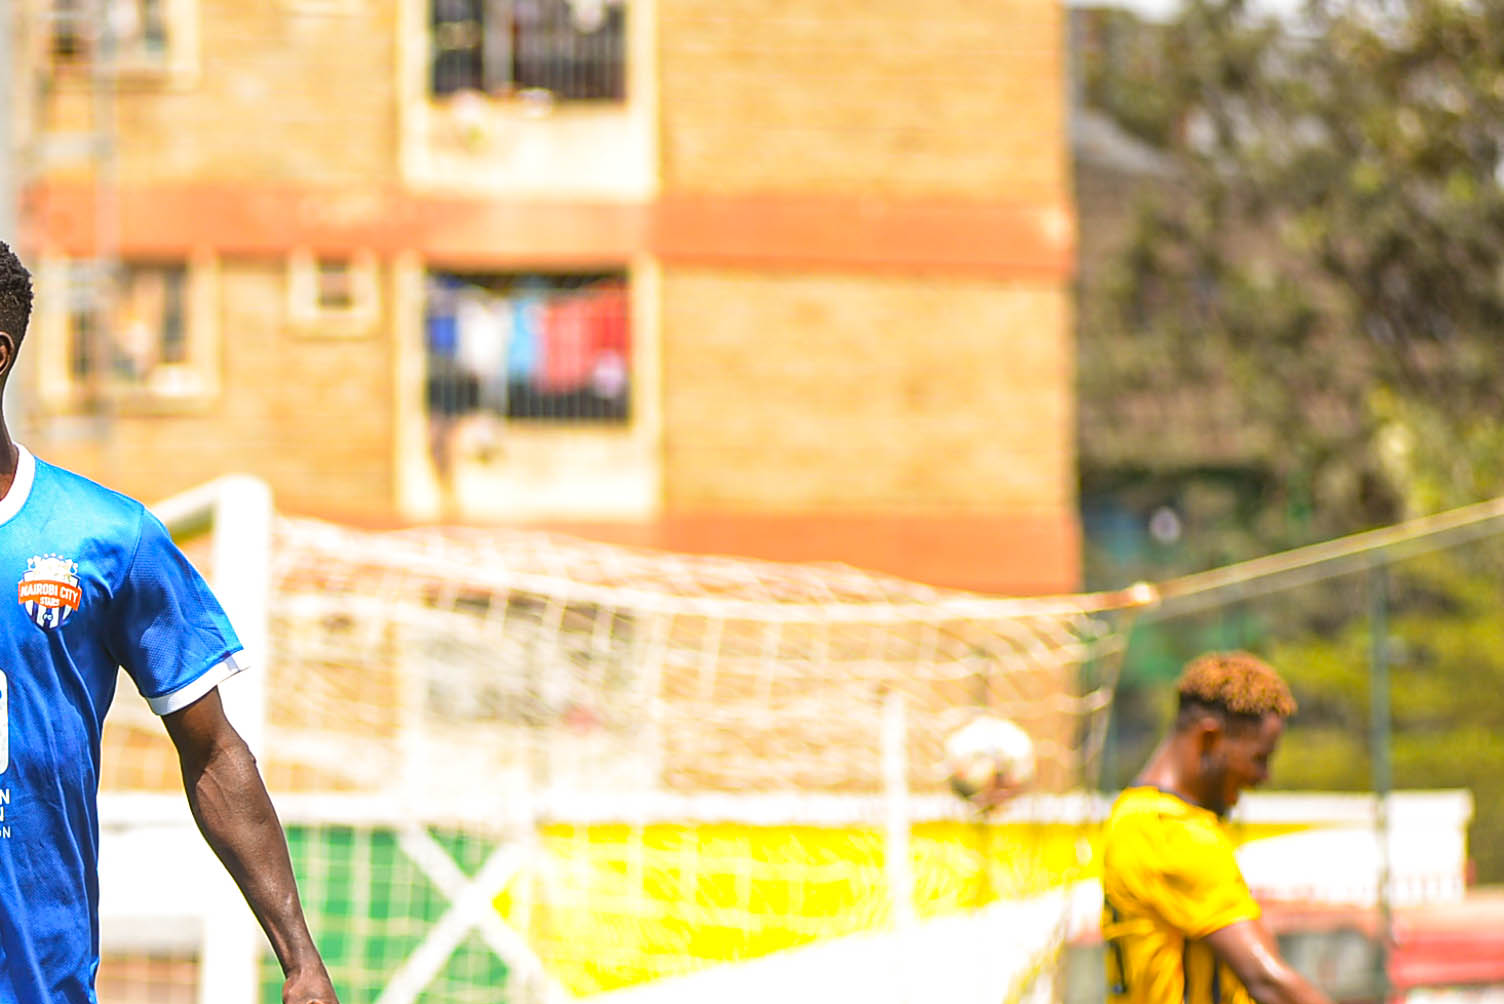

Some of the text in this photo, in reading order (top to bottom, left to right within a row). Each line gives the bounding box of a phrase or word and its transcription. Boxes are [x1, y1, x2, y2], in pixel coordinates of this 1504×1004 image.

[21, 584, 78, 603] NAIROBI CITY
[40, 597, 60, 606] STARS
